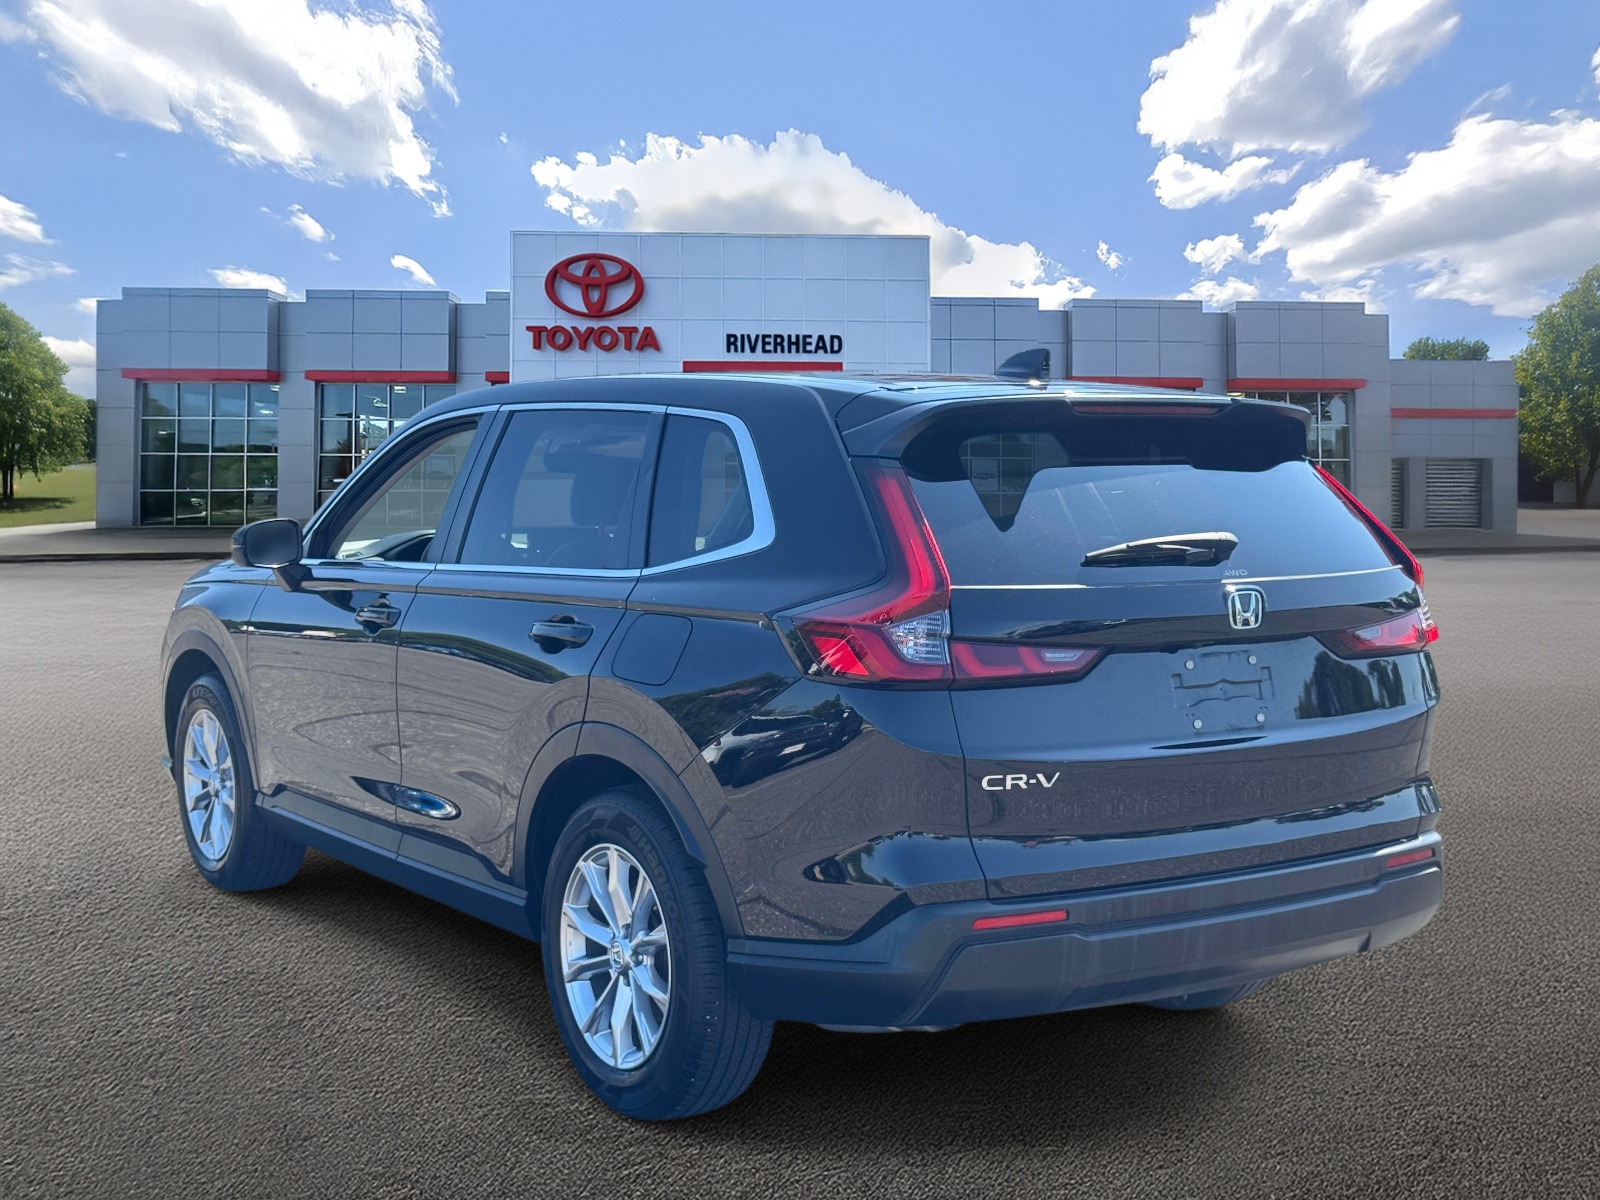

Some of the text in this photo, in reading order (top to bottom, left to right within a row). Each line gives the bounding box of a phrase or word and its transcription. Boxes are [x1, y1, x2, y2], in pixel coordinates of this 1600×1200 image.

[526, 325, 661, 352] TOYOTA
[726, 333, 843, 354] RIVERHEAD
[1223, 569, 1248, 577] AWD
[981, 772, 1060, 791] CR-V
